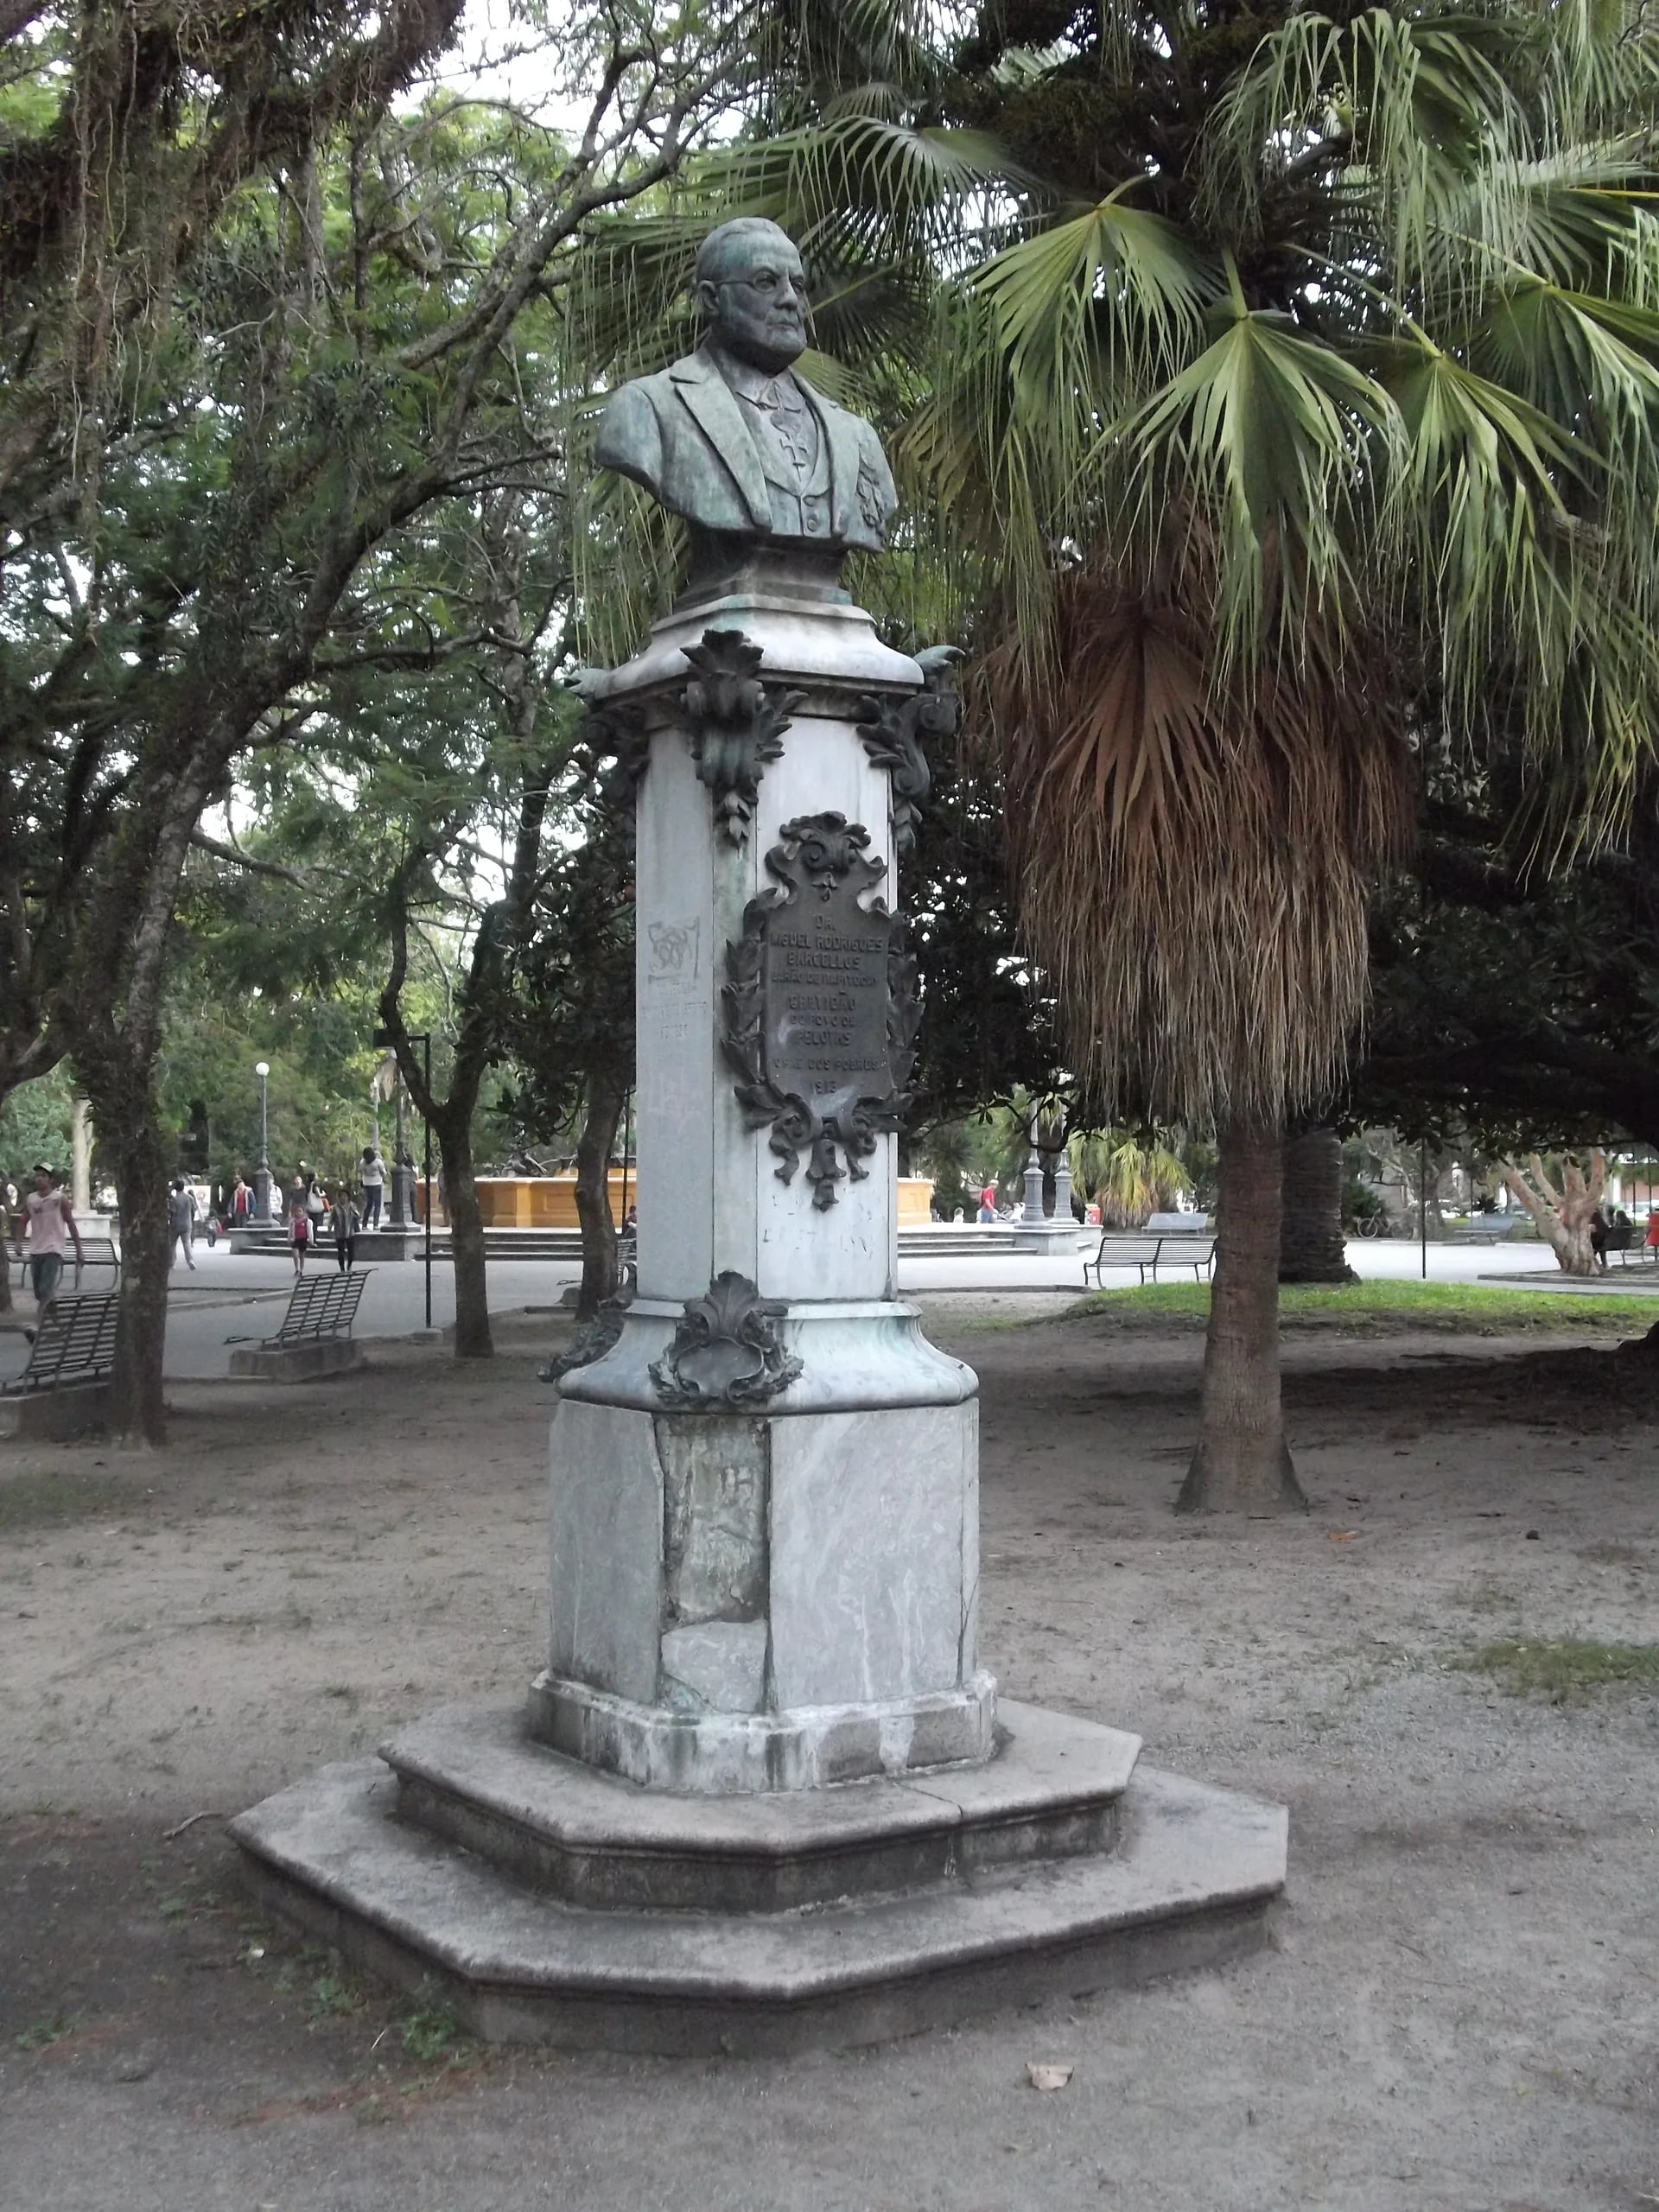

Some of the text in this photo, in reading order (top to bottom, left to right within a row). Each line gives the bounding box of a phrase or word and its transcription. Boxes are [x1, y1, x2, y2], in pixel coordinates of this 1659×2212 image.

[815, 914, 836, 931] DR.
[770, 932, 884, 953] MIGUEL RODRIGUES
[786, 950, 861, 970] BARCELLOS
[787, 990, 856, 1012] GRATIDÃO
[809, 1014, 838, 1027] POVO
[842, 1015, 856, 1028] DE
[798, 1029, 851, 1046] PELOTAS
[807, 1058, 830, 1071] DOS
